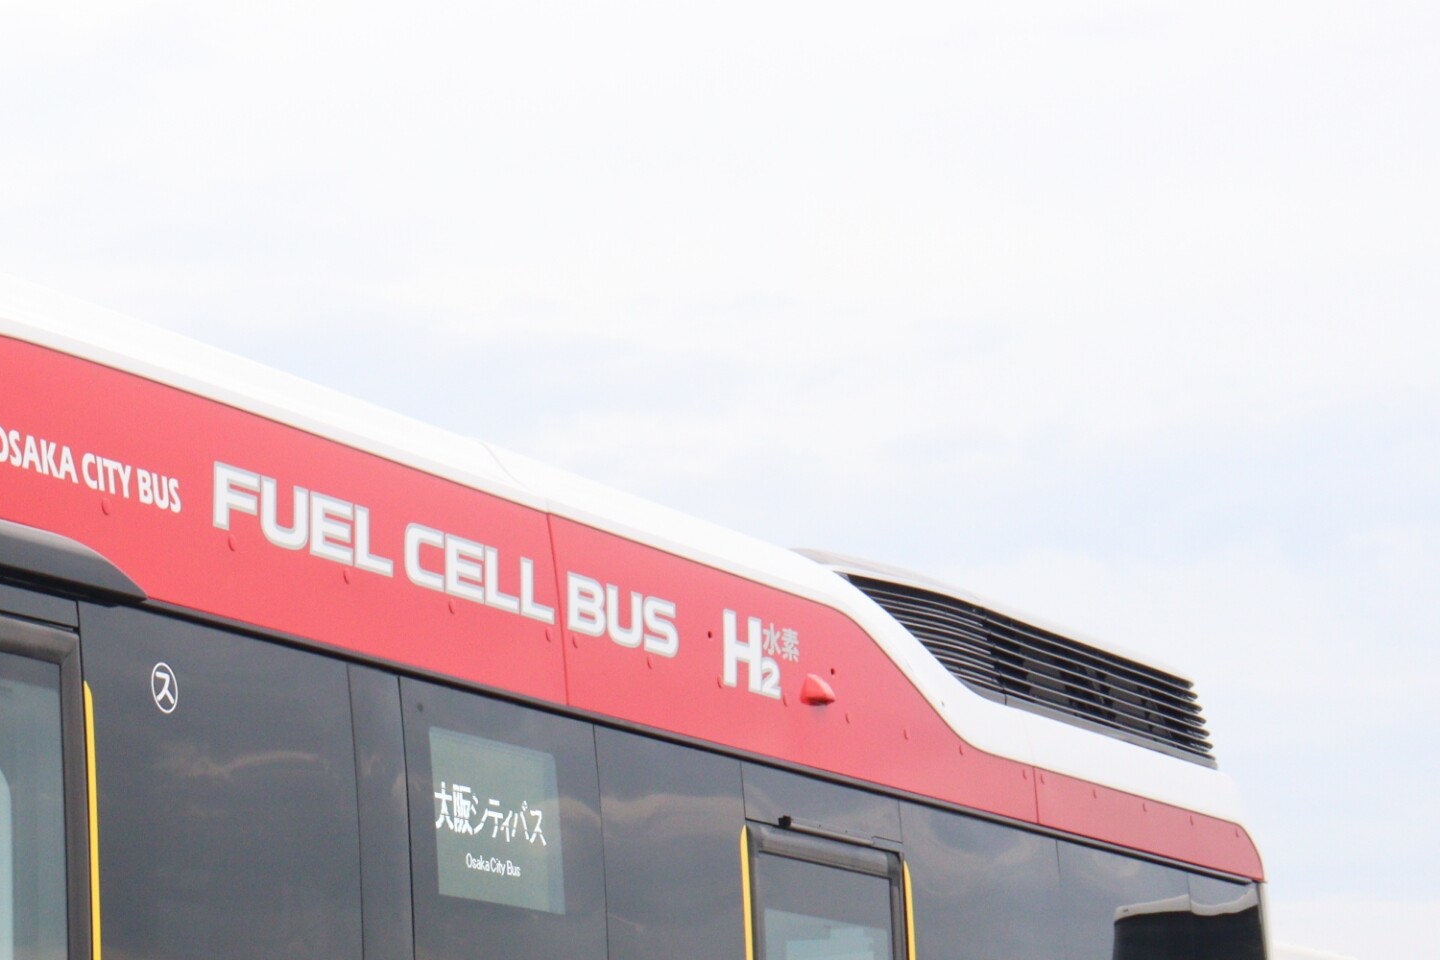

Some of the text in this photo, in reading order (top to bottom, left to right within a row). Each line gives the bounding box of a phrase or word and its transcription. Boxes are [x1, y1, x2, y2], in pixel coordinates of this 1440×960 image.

[81, 452, 132, 499] CITY
[136, 468, 182, 514] BUS
[213, 460, 680, 659] FUEL CELL BUS
[762, 622, 800, 663] 水素
[434, 781, 547, 846] 大阪シティバス
[465, 853, 521, 878] Osaka City Bus
